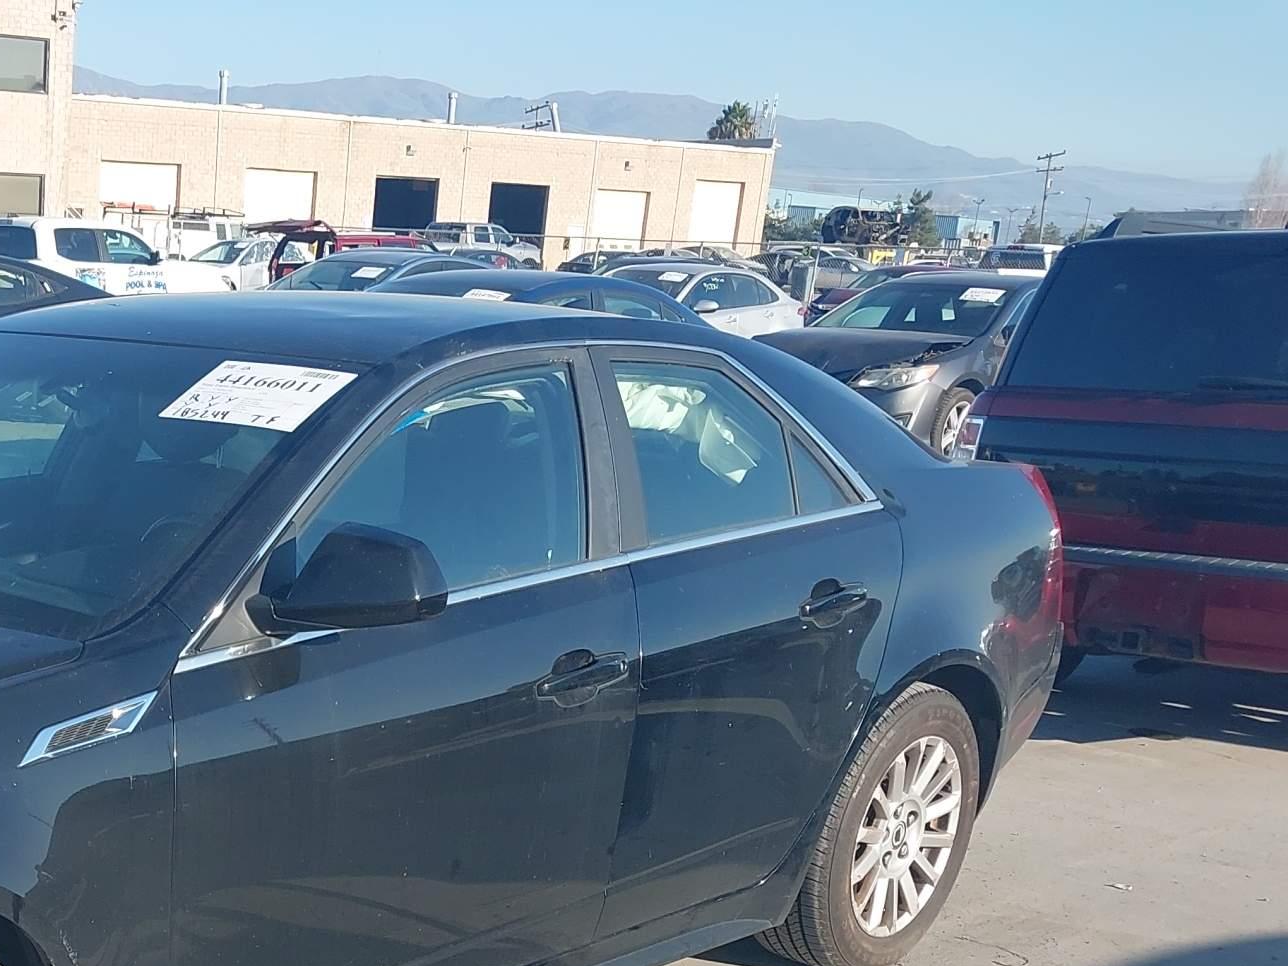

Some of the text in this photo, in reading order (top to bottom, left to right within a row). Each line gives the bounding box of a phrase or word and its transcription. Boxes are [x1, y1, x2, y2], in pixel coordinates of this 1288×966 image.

[126, 280, 145, 291] POOL
[154, 281, 168, 293] SPA
[215, 373, 323, 394] 44166011
